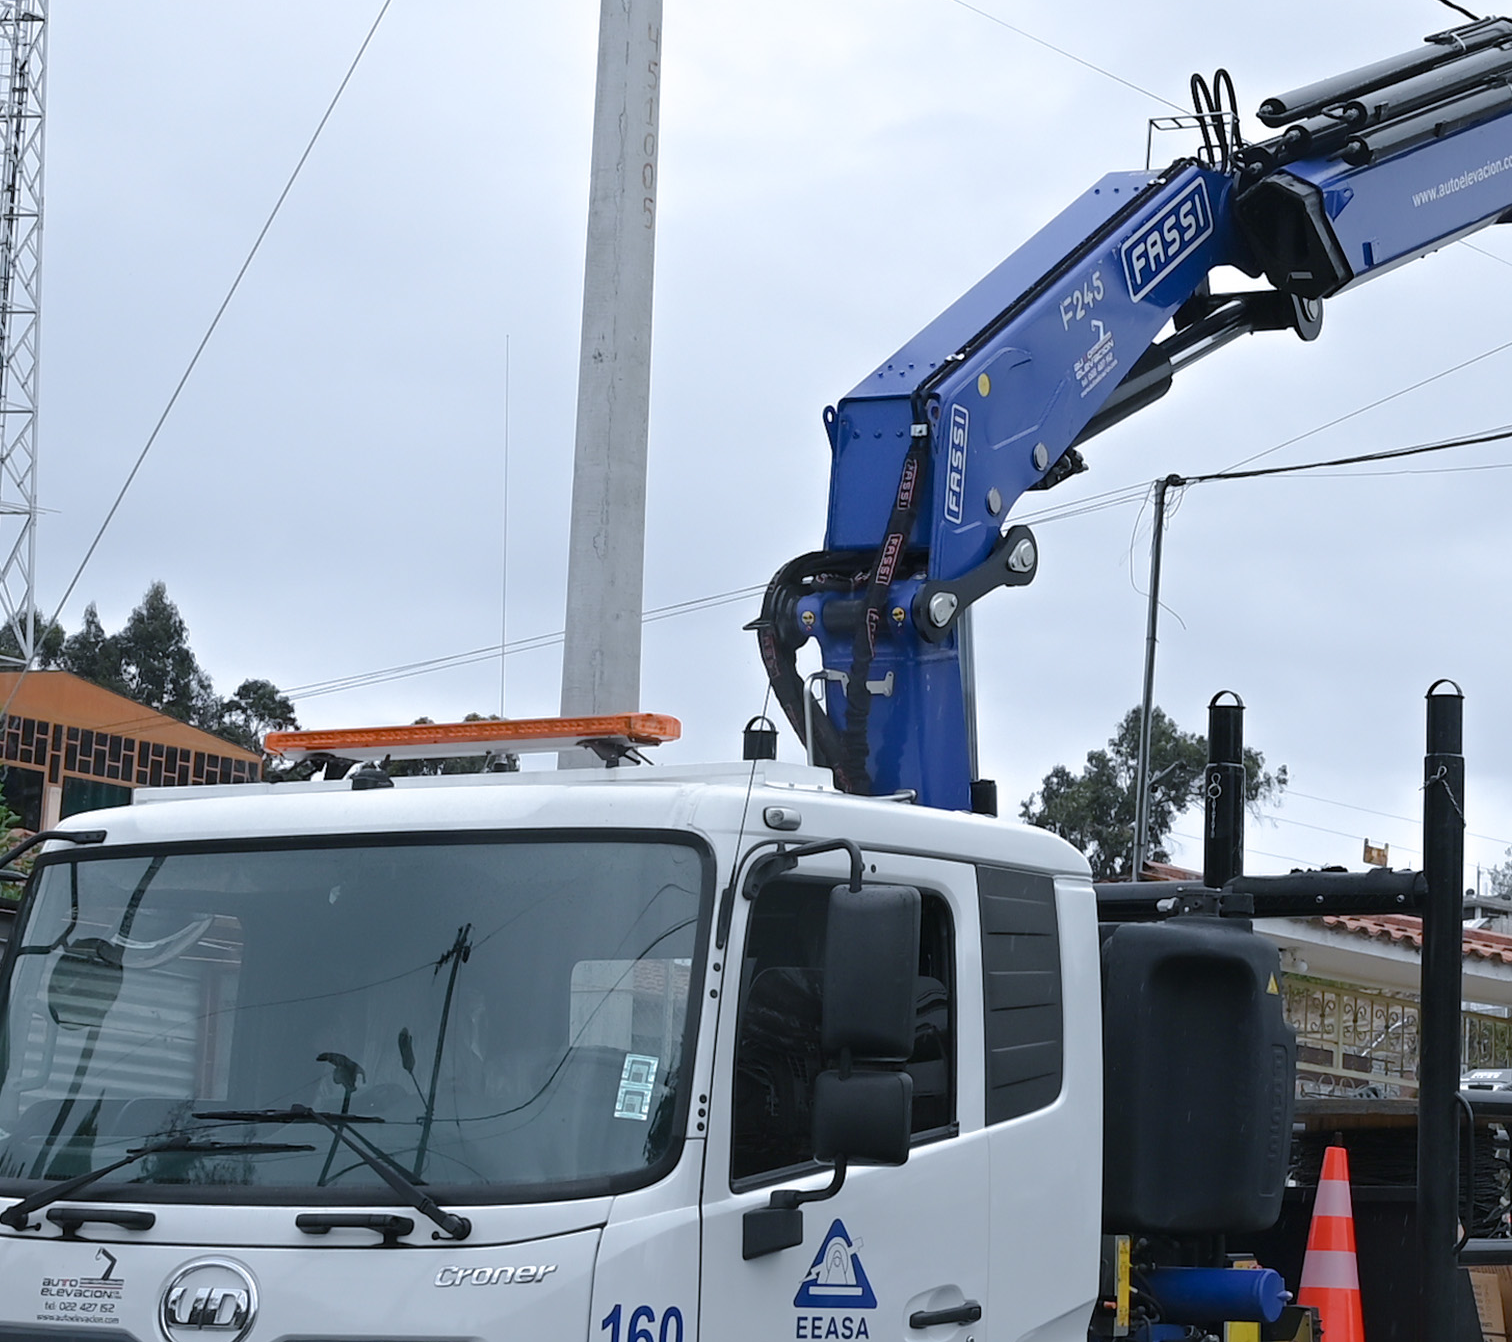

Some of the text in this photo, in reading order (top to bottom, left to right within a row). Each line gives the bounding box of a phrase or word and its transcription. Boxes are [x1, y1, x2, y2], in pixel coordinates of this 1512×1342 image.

[1131, 194, 1205, 285] FASSI
[1059, 271, 1104, 331] F245
[948, 411, 965, 513] FASSI
[879, 536, 900, 584] FASSI
[434, 1264, 558, 1288] Croner
[59, 1301, 78, 1311] 022
[79, 1302, 98, 1312] 427
[99, 1303, 115, 1313] 152
[168, 1287, 249, 1330] UD
[796, 1316, 869, 1339] EEASA
